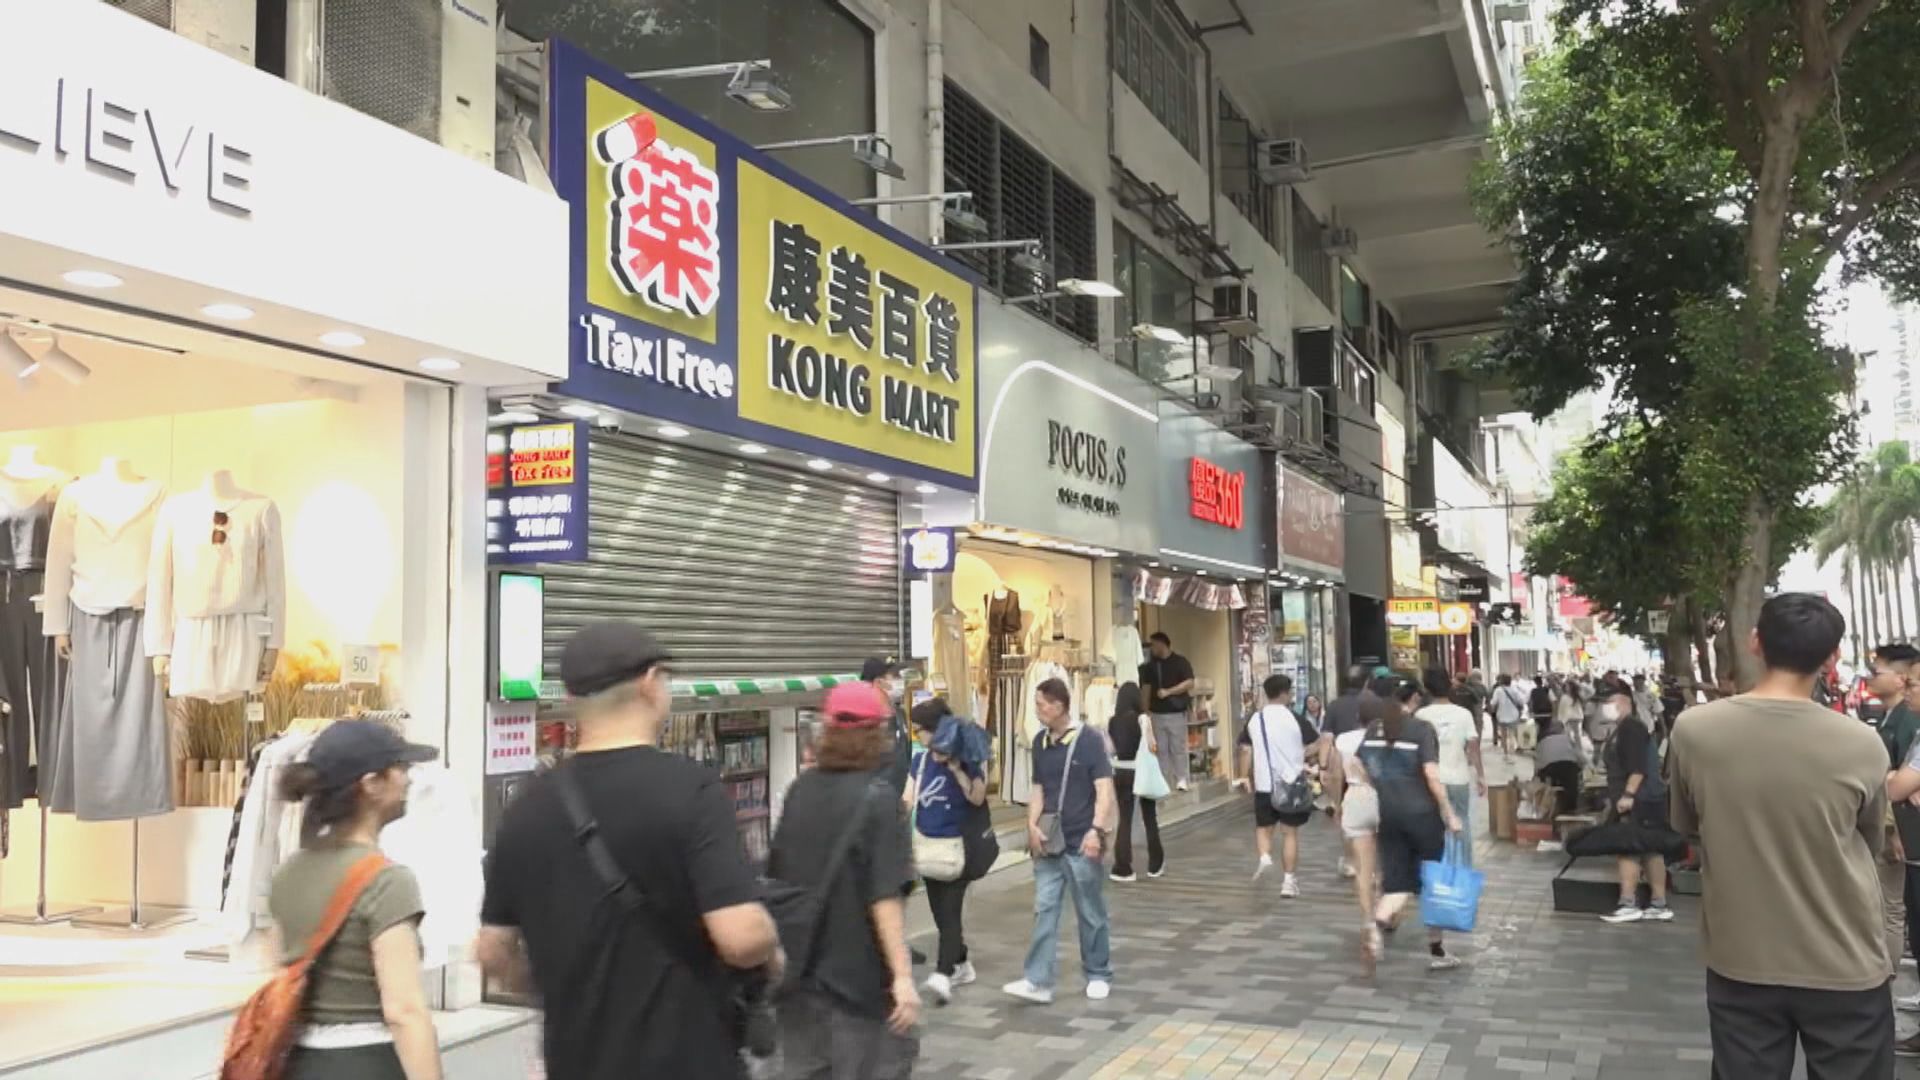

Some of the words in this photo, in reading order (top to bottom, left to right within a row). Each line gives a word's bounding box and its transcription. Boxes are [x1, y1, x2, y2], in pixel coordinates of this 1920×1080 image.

[766, 219, 960, 383] 康美百貨
[581, 313, 654, 377] Tax
[657, 338, 734, 399] Free
[768, 333, 872, 417] KONG
[881, 375, 959, 443] MART
[352, 656, 368, 673] 50
